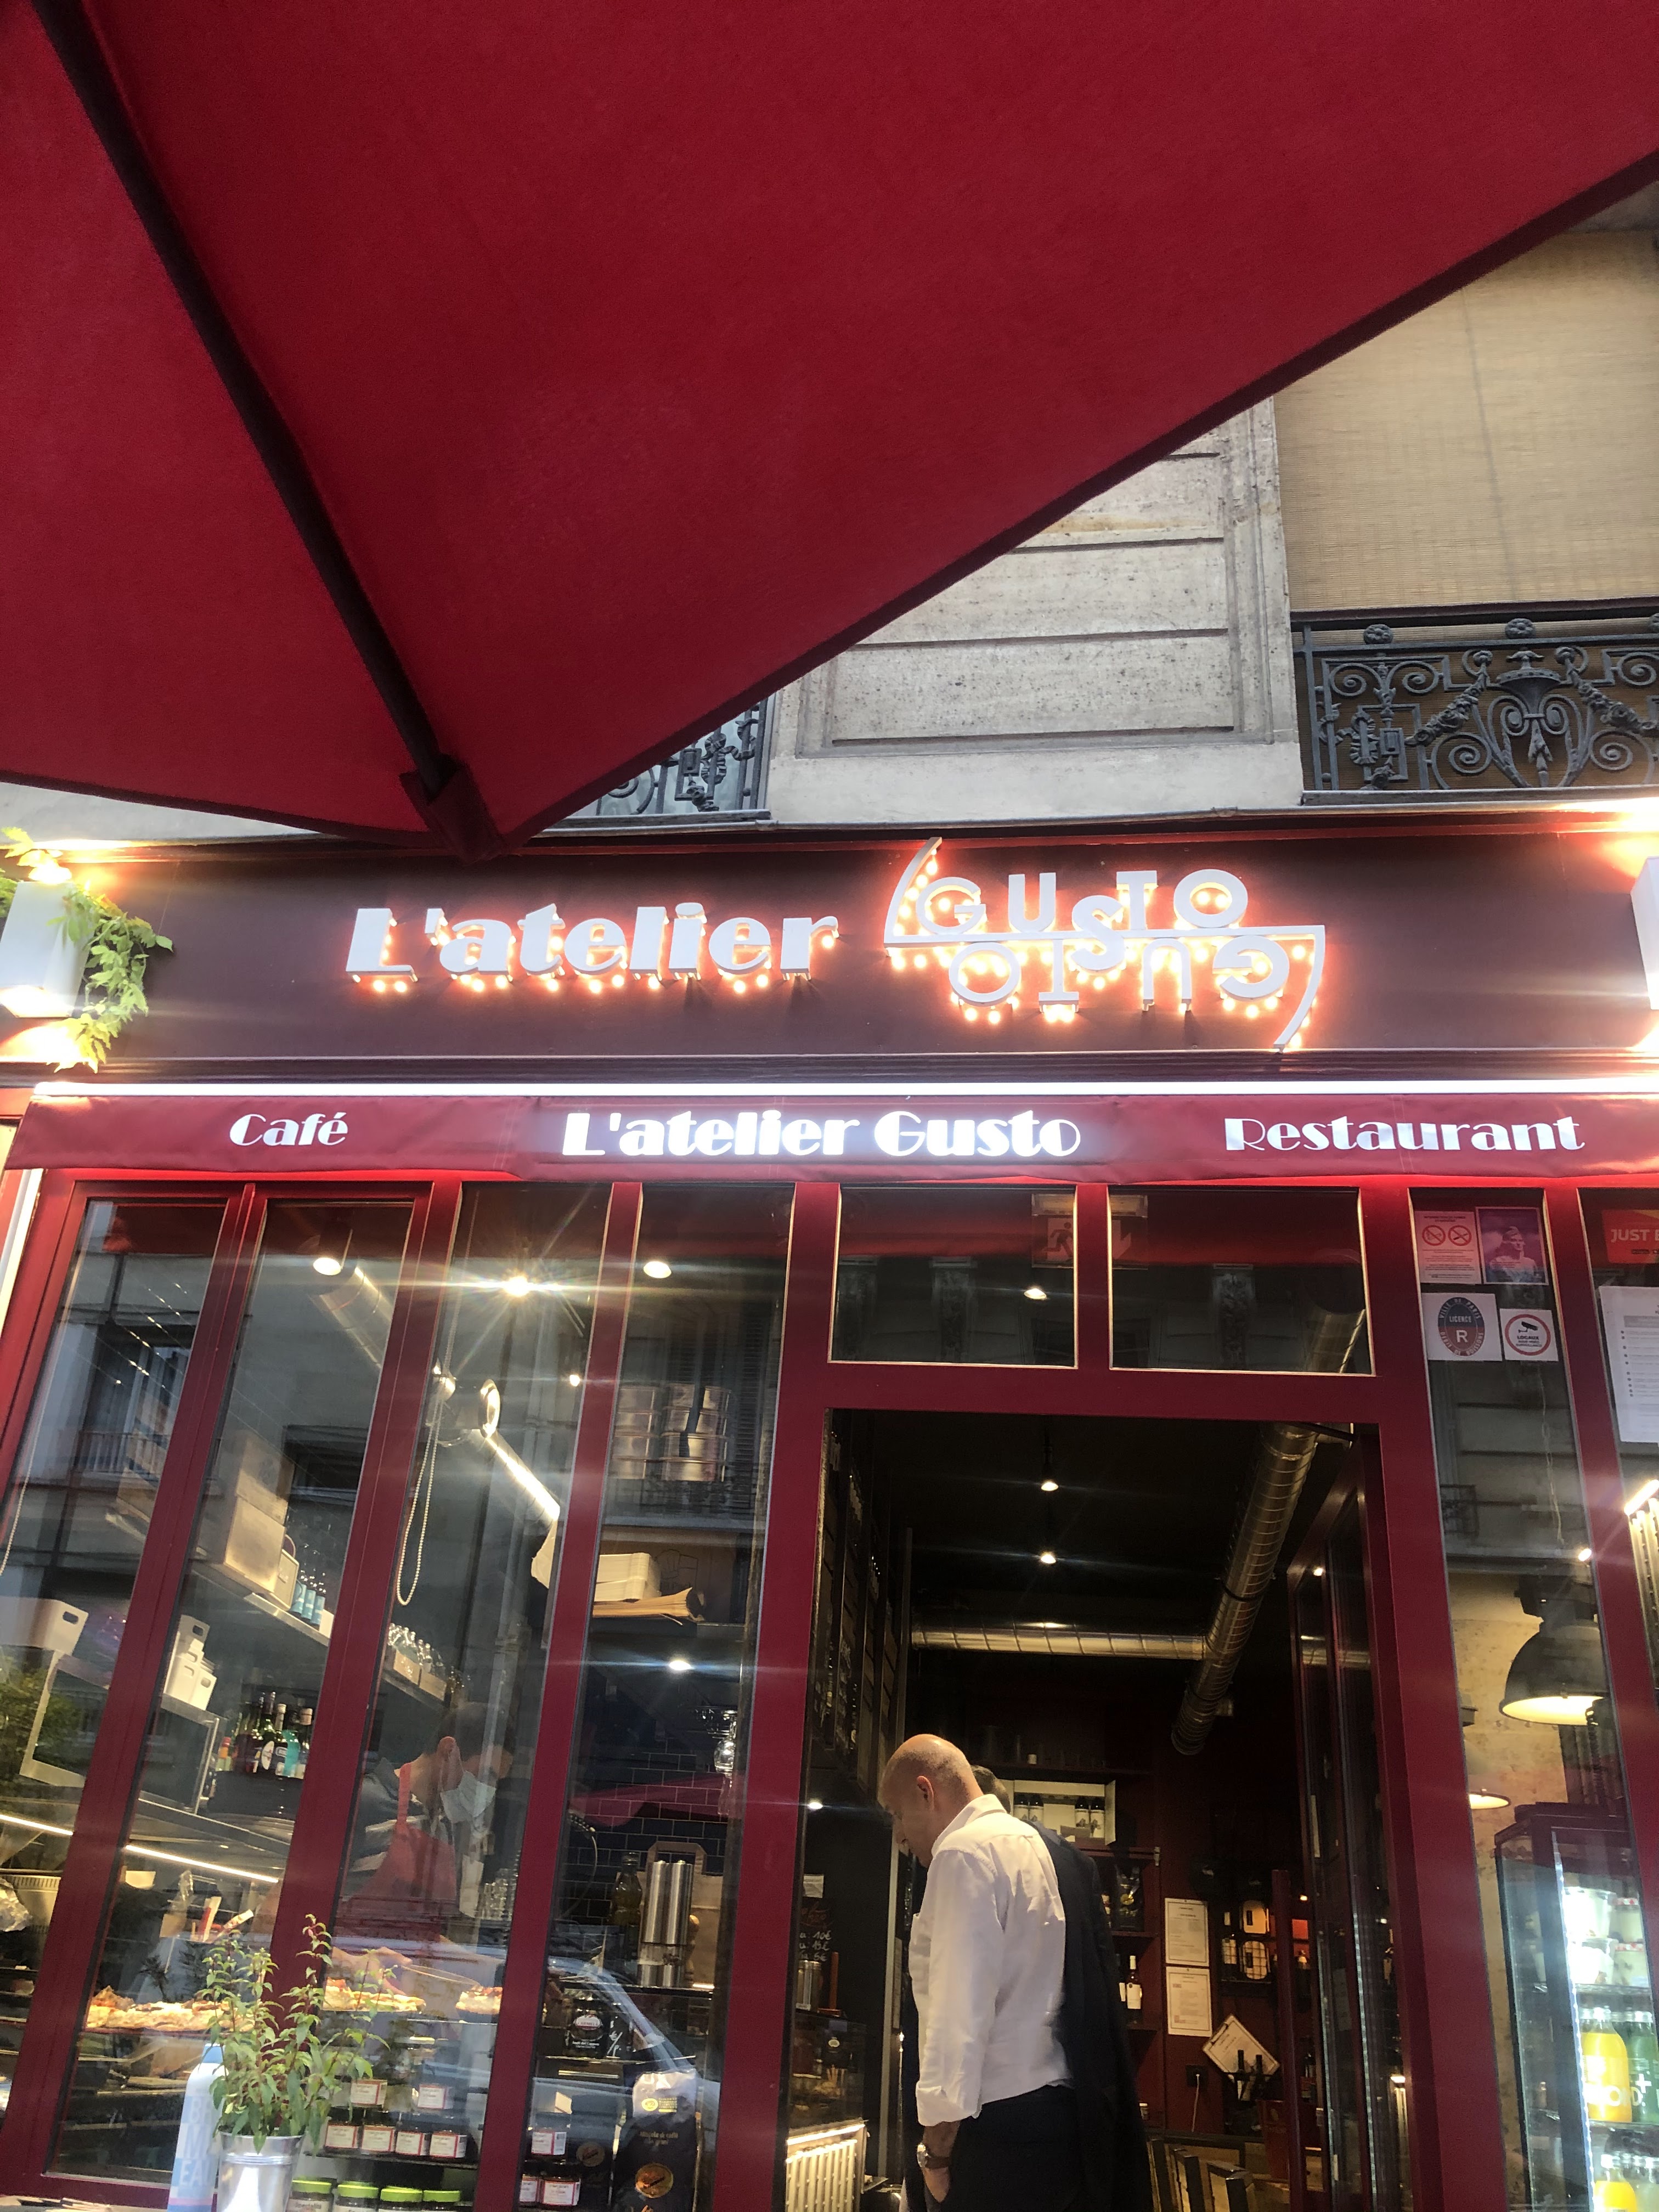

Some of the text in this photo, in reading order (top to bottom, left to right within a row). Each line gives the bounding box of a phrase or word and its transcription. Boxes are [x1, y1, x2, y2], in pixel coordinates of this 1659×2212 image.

[345, 902, 838, 979] L'atelier
[229, 1111, 348, 1146] Café
[562, 1109, 1081, 1157] L'atelier Gusto
[1224, 1115, 1585, 1151] Restaurant
[1611, 1228, 1650, 1243] JUST
[1455, 1329, 1469, 1343] R
